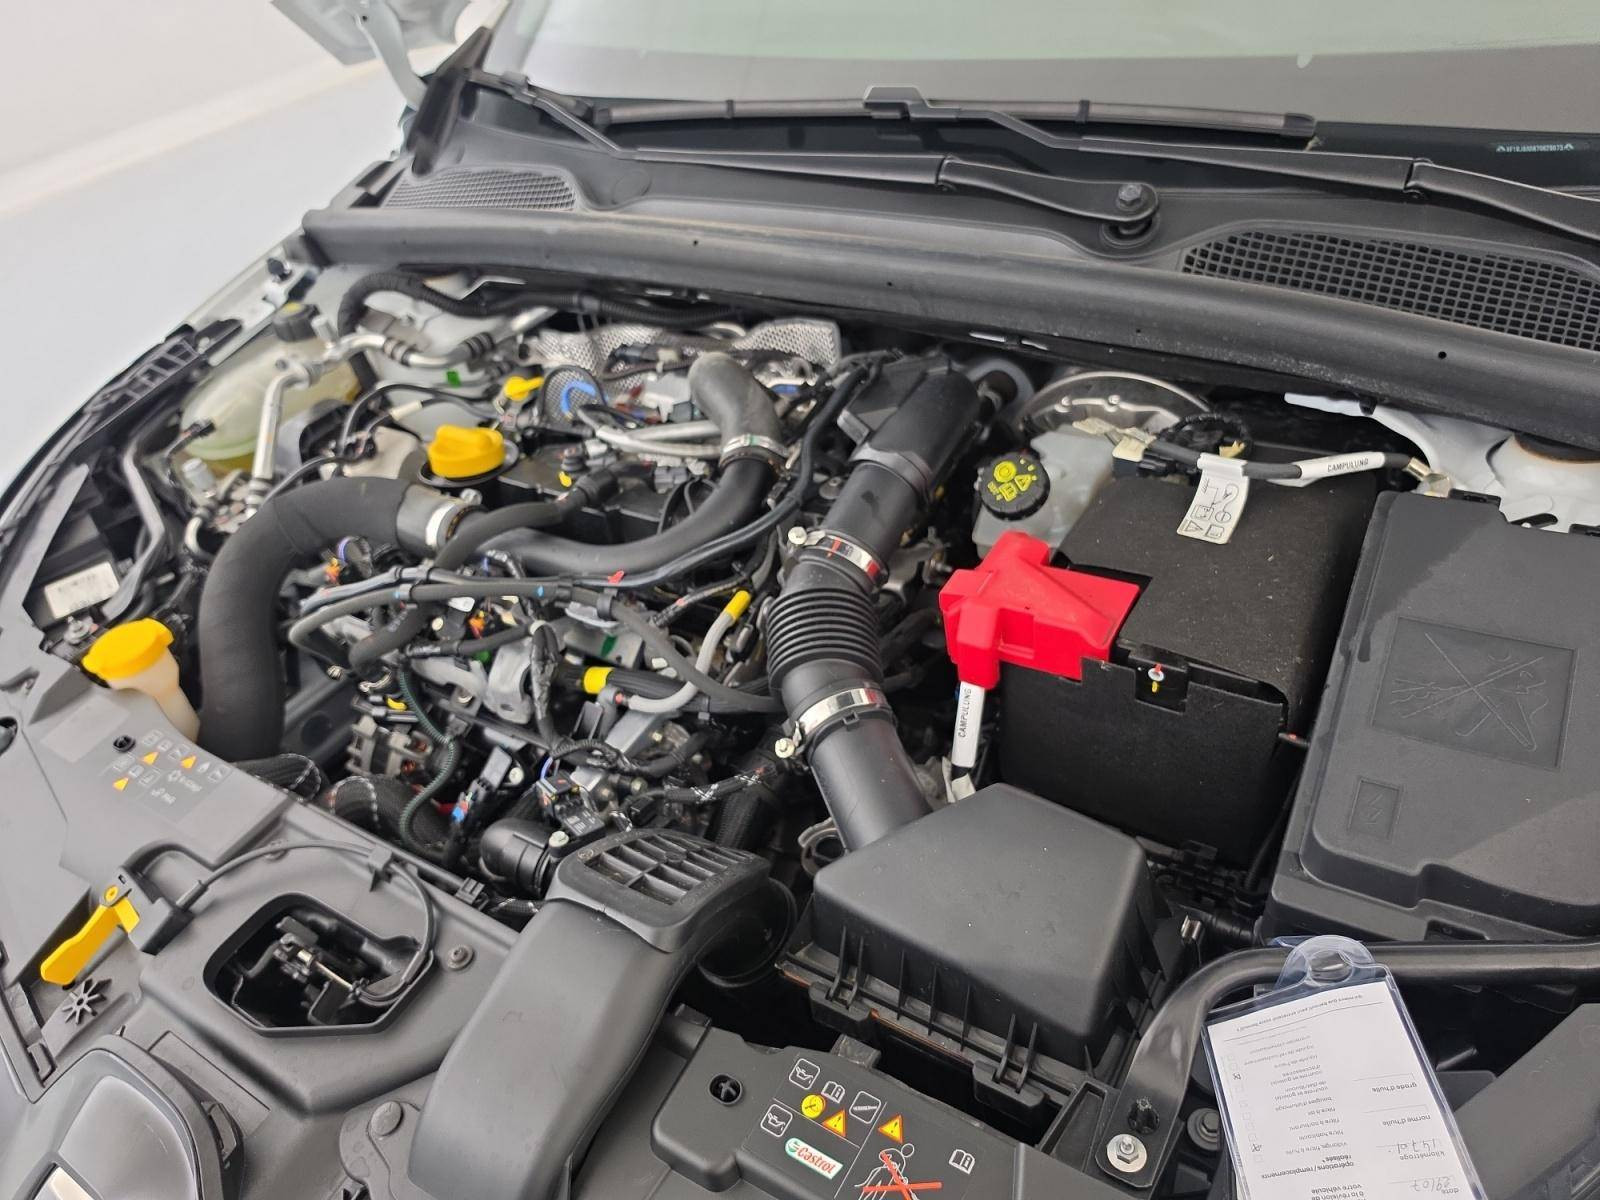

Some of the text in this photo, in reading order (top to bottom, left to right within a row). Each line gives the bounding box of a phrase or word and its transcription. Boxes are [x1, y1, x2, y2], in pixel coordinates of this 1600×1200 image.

[1327, 457, 1369, 473] CAMPULUNG
[957, 688, 972, 738] CAMPULUNG
[1382, 1114, 1431, 1126] norme d'huile
[797, 1147, 836, 1174] Castrol
[1317, 1162, 1354, 1171] opérations
[1261, 1167, 1314, 1179] remplacements
[1311, 1185, 1342, 1194] véhicule
